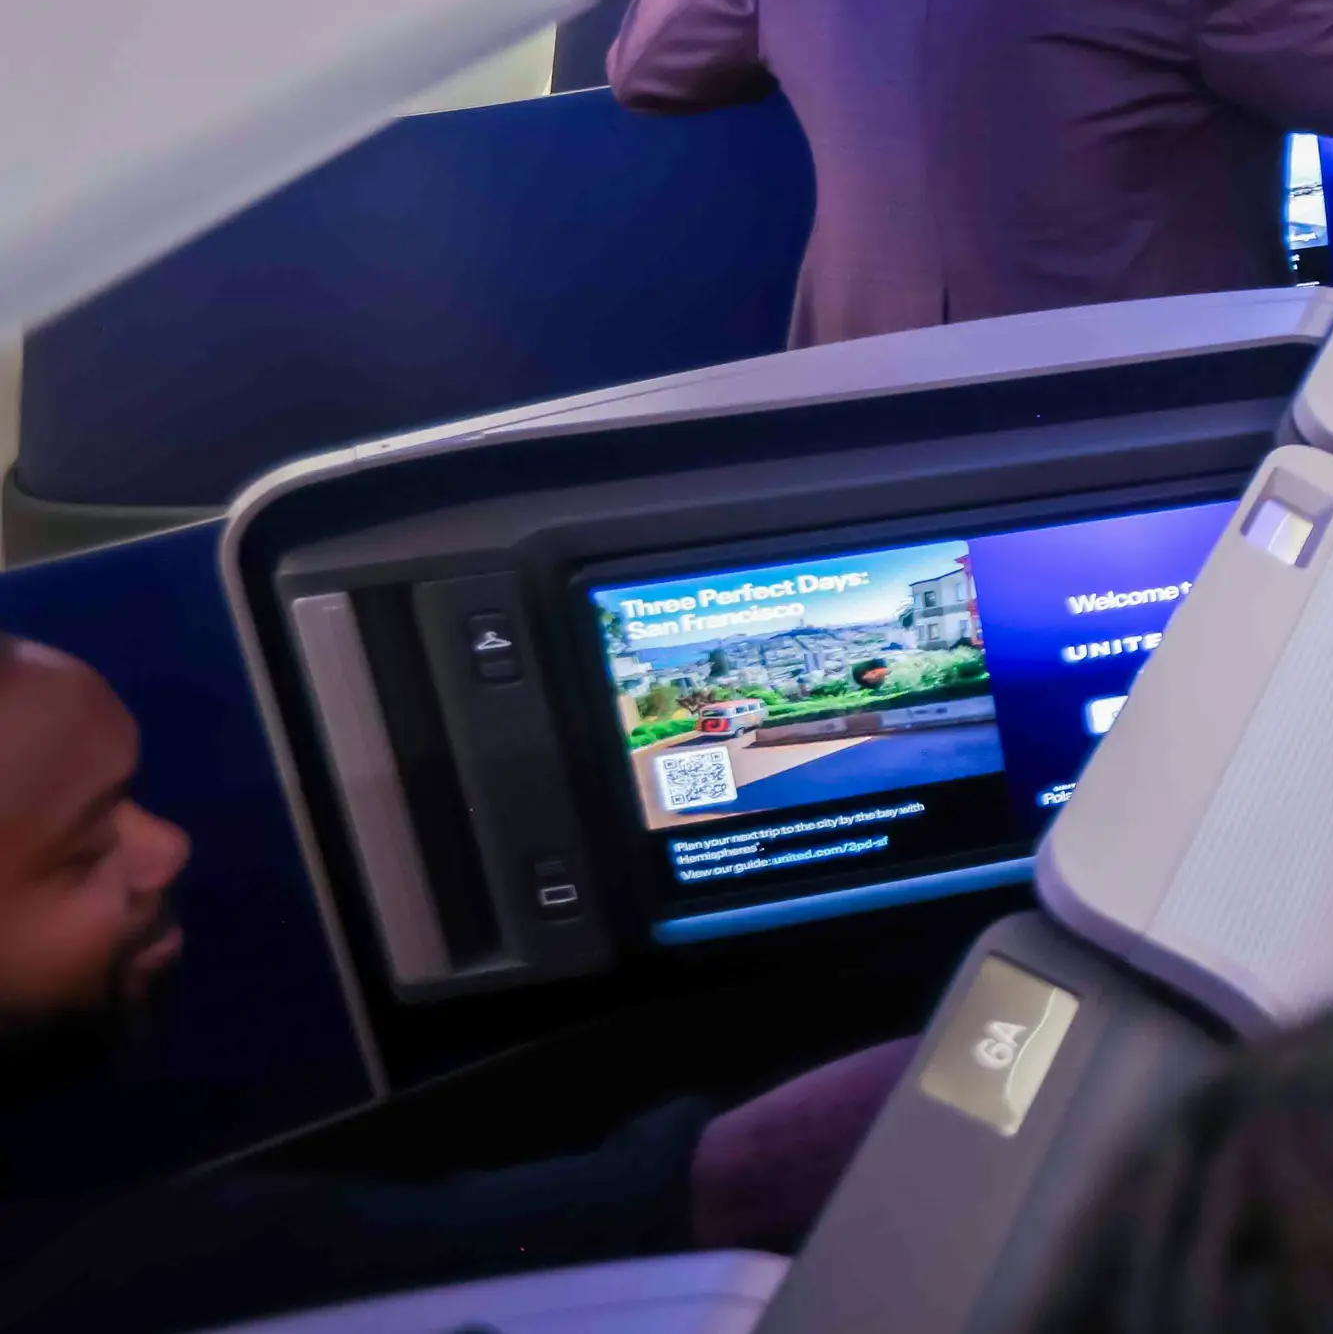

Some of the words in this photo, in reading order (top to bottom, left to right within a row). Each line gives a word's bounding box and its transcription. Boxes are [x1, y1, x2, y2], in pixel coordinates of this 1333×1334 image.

[620, 596, 697, 619] Three
[697, 581, 797, 608] Perfect
[797, 571, 870, 594] Days:
[1067, 584, 1180, 615] Welcome
[627, 617, 679, 641] San
[680, 602, 806, 633] Francisco
[674, 840, 702, 854] Plan
[704, 836, 730, 849] your
[731, 831, 758, 843] next
[759, 826, 781, 842] trip
[780, 824, 794, 836] to
[794, 820, 817, 833] the
[816, 816, 838, 830] city
[838, 813, 854, 829] by
[854, 810, 876, 824] the
[876, 808, 898, 822] bay
[898, 802, 925, 815] with
[680, 866, 712, 881] View
[713, 864, 733, 877] our
[733, 858, 773, 875] guide:
